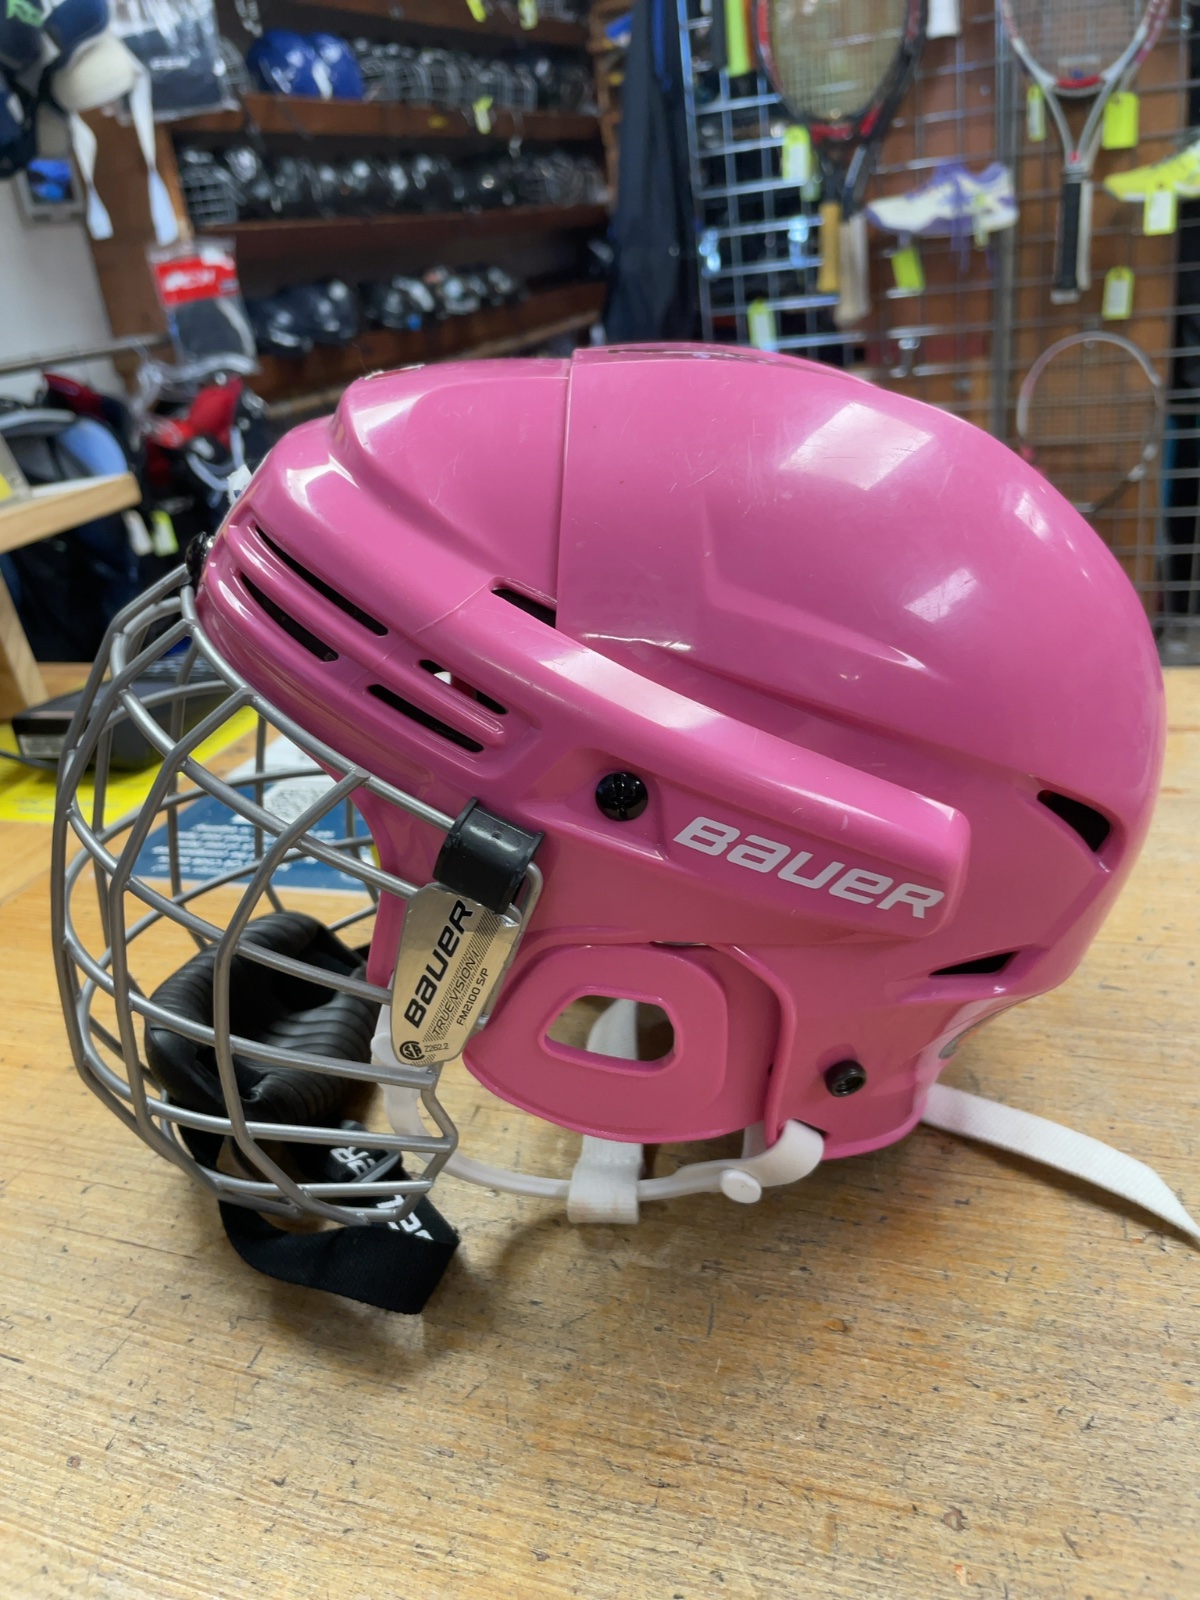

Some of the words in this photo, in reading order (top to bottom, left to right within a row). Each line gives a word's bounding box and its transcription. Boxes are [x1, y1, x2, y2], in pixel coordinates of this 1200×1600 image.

[432, 1001, 455, 1036] TRUE
[449, 956, 476, 1000] VISION
[456, 986, 481, 1026] FM2100
[476, 967, 489, 987] S/P
